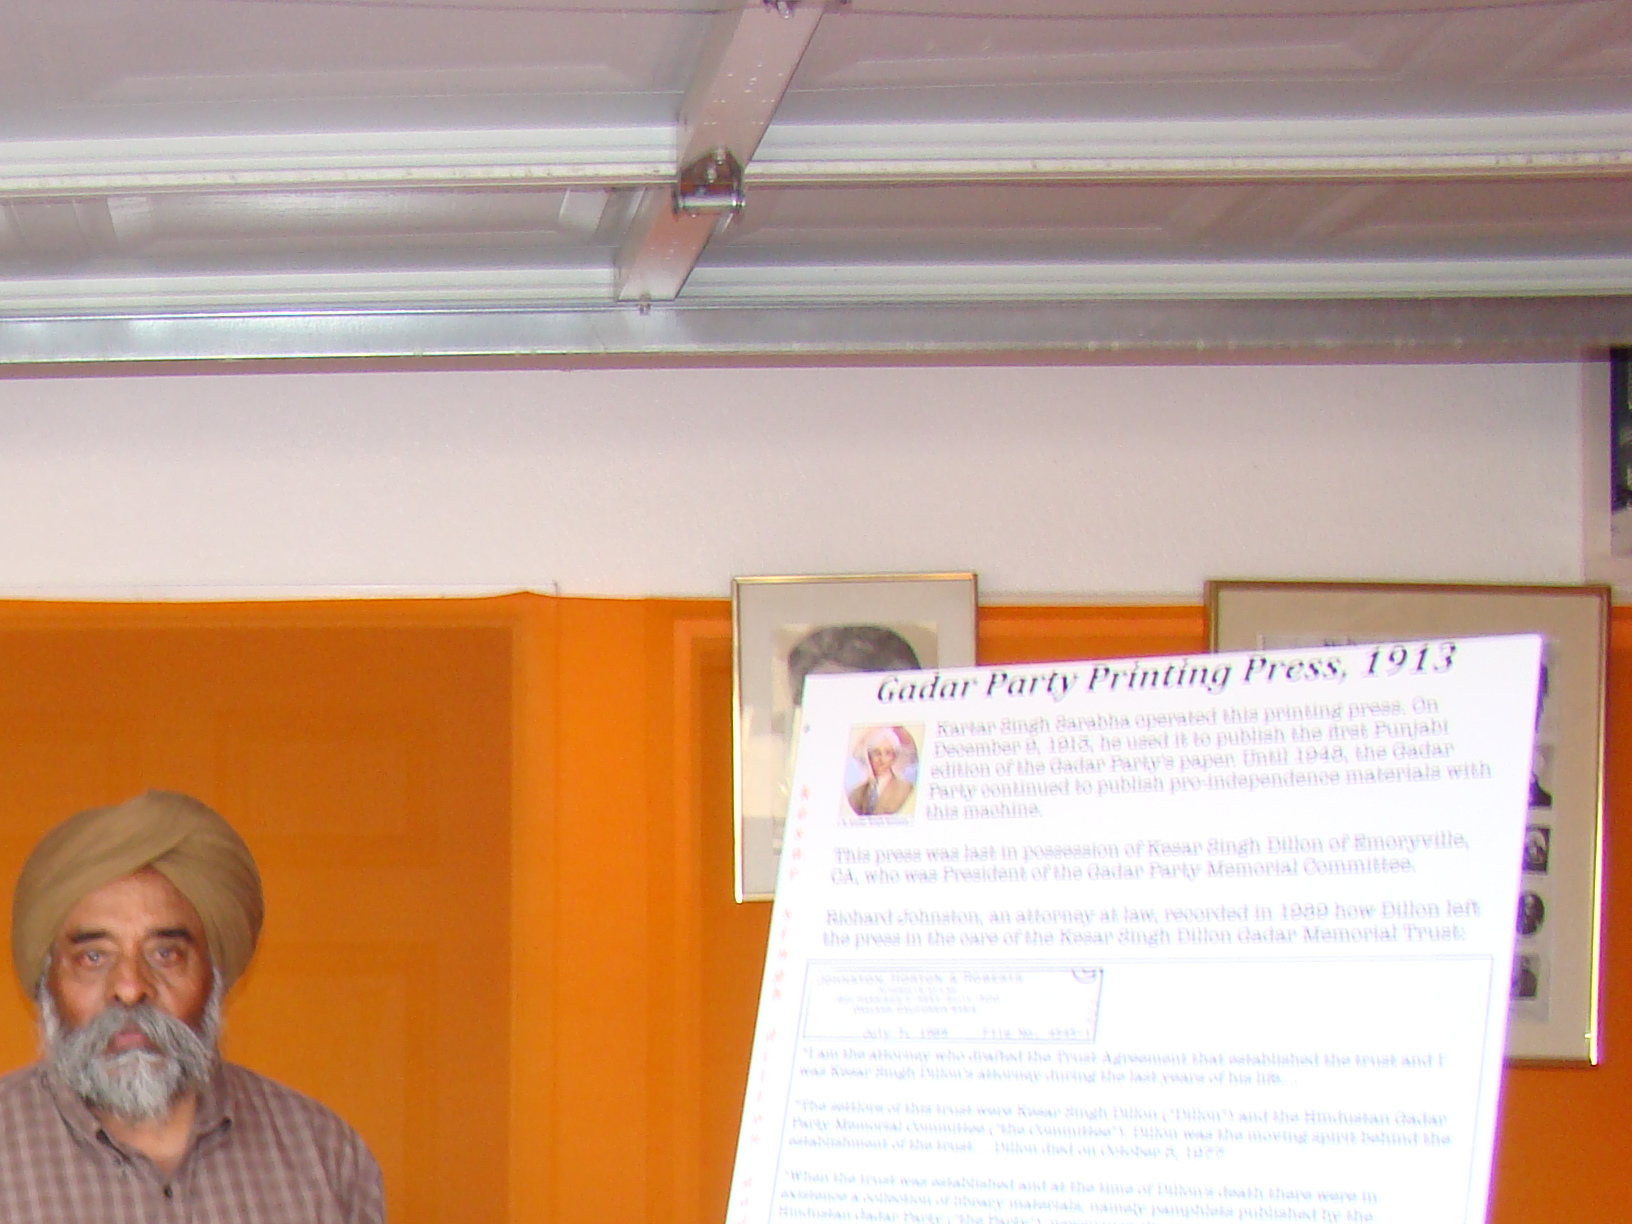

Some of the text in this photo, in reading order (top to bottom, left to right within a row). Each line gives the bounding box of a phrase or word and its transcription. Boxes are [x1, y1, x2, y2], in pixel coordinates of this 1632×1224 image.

[876, 641, 1457, 702] Gadar Party Printing Press, 1913
[936, 720, 997, 738] Kartar
[999, 716, 1050, 738] Singh
[1134, 707, 1217, 731] operated
[1221, 706, 1259, 724] this
[1263, 702, 1344, 726] printing
[1411, 695, 1439, 715] On
[933, 739, 1021, 758] December
[1098, 733, 1123, 752] he
[1125, 731, 1170, 750] used
[1173, 731, 1189, 749] it
[1191, 731, 1212, 748] to
[1215, 726, 1286, 750] publish
[1290, 724, 1323, 743] the
[1373, 719, 1449, 744] Punjabi
[929, 761, 991, 779] edition
[994, 758, 1015, 777] of
[1016, 758, 1046, 776] the
[1049, 756, 1106, 775] Gadar
[1109, 754, 1175, 775] Party's
[1242, 747, 1289, 767] Until
[1354, 743, 1388, 762] the
[1391, 741, 1455, 760] Gadar
[927, 760, 1493, 802] Party continued to publish pro-independence materials with
[925, 803, 959, 821] this
[833, 846, 871, 864] This
[874, 848, 922, 866] press
[925, 847, 960, 862] was
[963, 843, 997, 861] last
[1000, 844, 1018, 861] in
[1022, 843, 1120, 864] possession
[1123, 839, 1145, 858] of
[1147, 839, 1203, 857] Kesar
[1206, 837, 1261, 861] Singh
[1266, 835, 1324, 854] Dillon
[1327, 833, 1351, 853] of
[830, 867, 859, 885] CA,
[864, 867, 901, 884] who
[904, 869, 938, 883] was
[942, 865, 1028, 882] President
[1030, 863, 1051, 881] of
[1052, 863, 1084, 880] the
[1086, 862, 1145, 880] Gadar
[1148, 861, 1202, 881] Party
[1206, 858, 1299, 877] Memorial
[825, 909, 893, 926] Richard
[988, 910, 1011, 925] an
[1015, 908, 1096, 927] attorney
[1098, 907, 1119, 923] at
[1164, 904, 1249, 922] recorded
[1253, 904, 1274, 921] in
[1334, 902, 1377, 920] how
[1380, 900, 1441, 919] Dillon
[1446, 898, 1482, 918] left
[822, 930, 851, 947] the
[854, 932, 901, 950] press
[905, 930, 923, 947] in
[926, 929, 956, 946] the
[959, 932, 1000, 946] care
[1002, 928, 1023, 946] of
[1024, 928, 1056, 945] the
[1059, 928, 1114, 945] Kesar
[1117, 927, 1171, 948] Singh
[1176, 926, 1232, 944] Dillon
[1236, 925, 1298, 944] Gadar
[1302, 924, 1398, 943] Memorial
